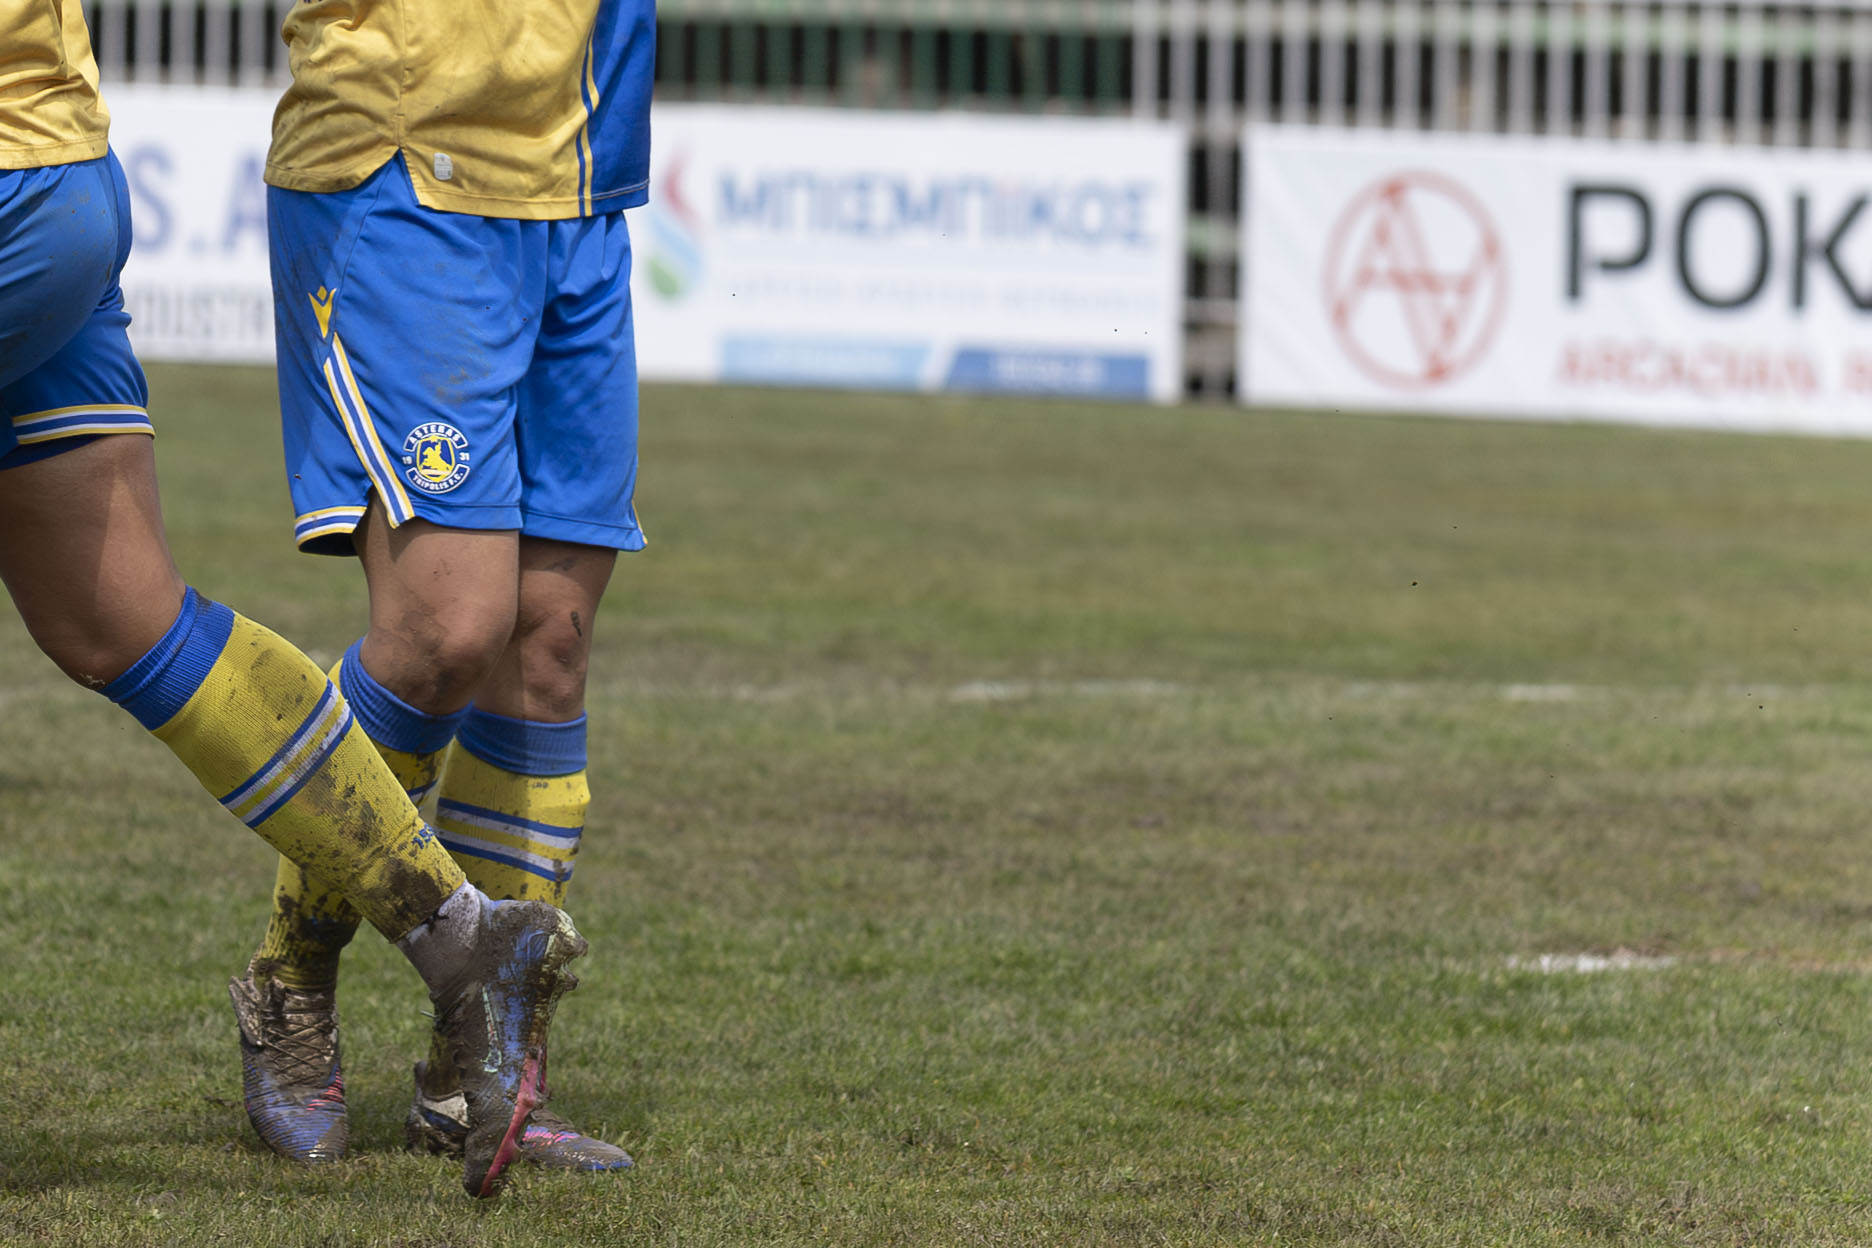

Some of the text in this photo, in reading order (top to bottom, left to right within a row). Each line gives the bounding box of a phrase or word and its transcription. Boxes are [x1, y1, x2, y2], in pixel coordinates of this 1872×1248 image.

[408, 424, 460, 444] ASTERAS
[459, 452, 469, 461] 31
[413, 475, 449, 490] TRIPOLIS
